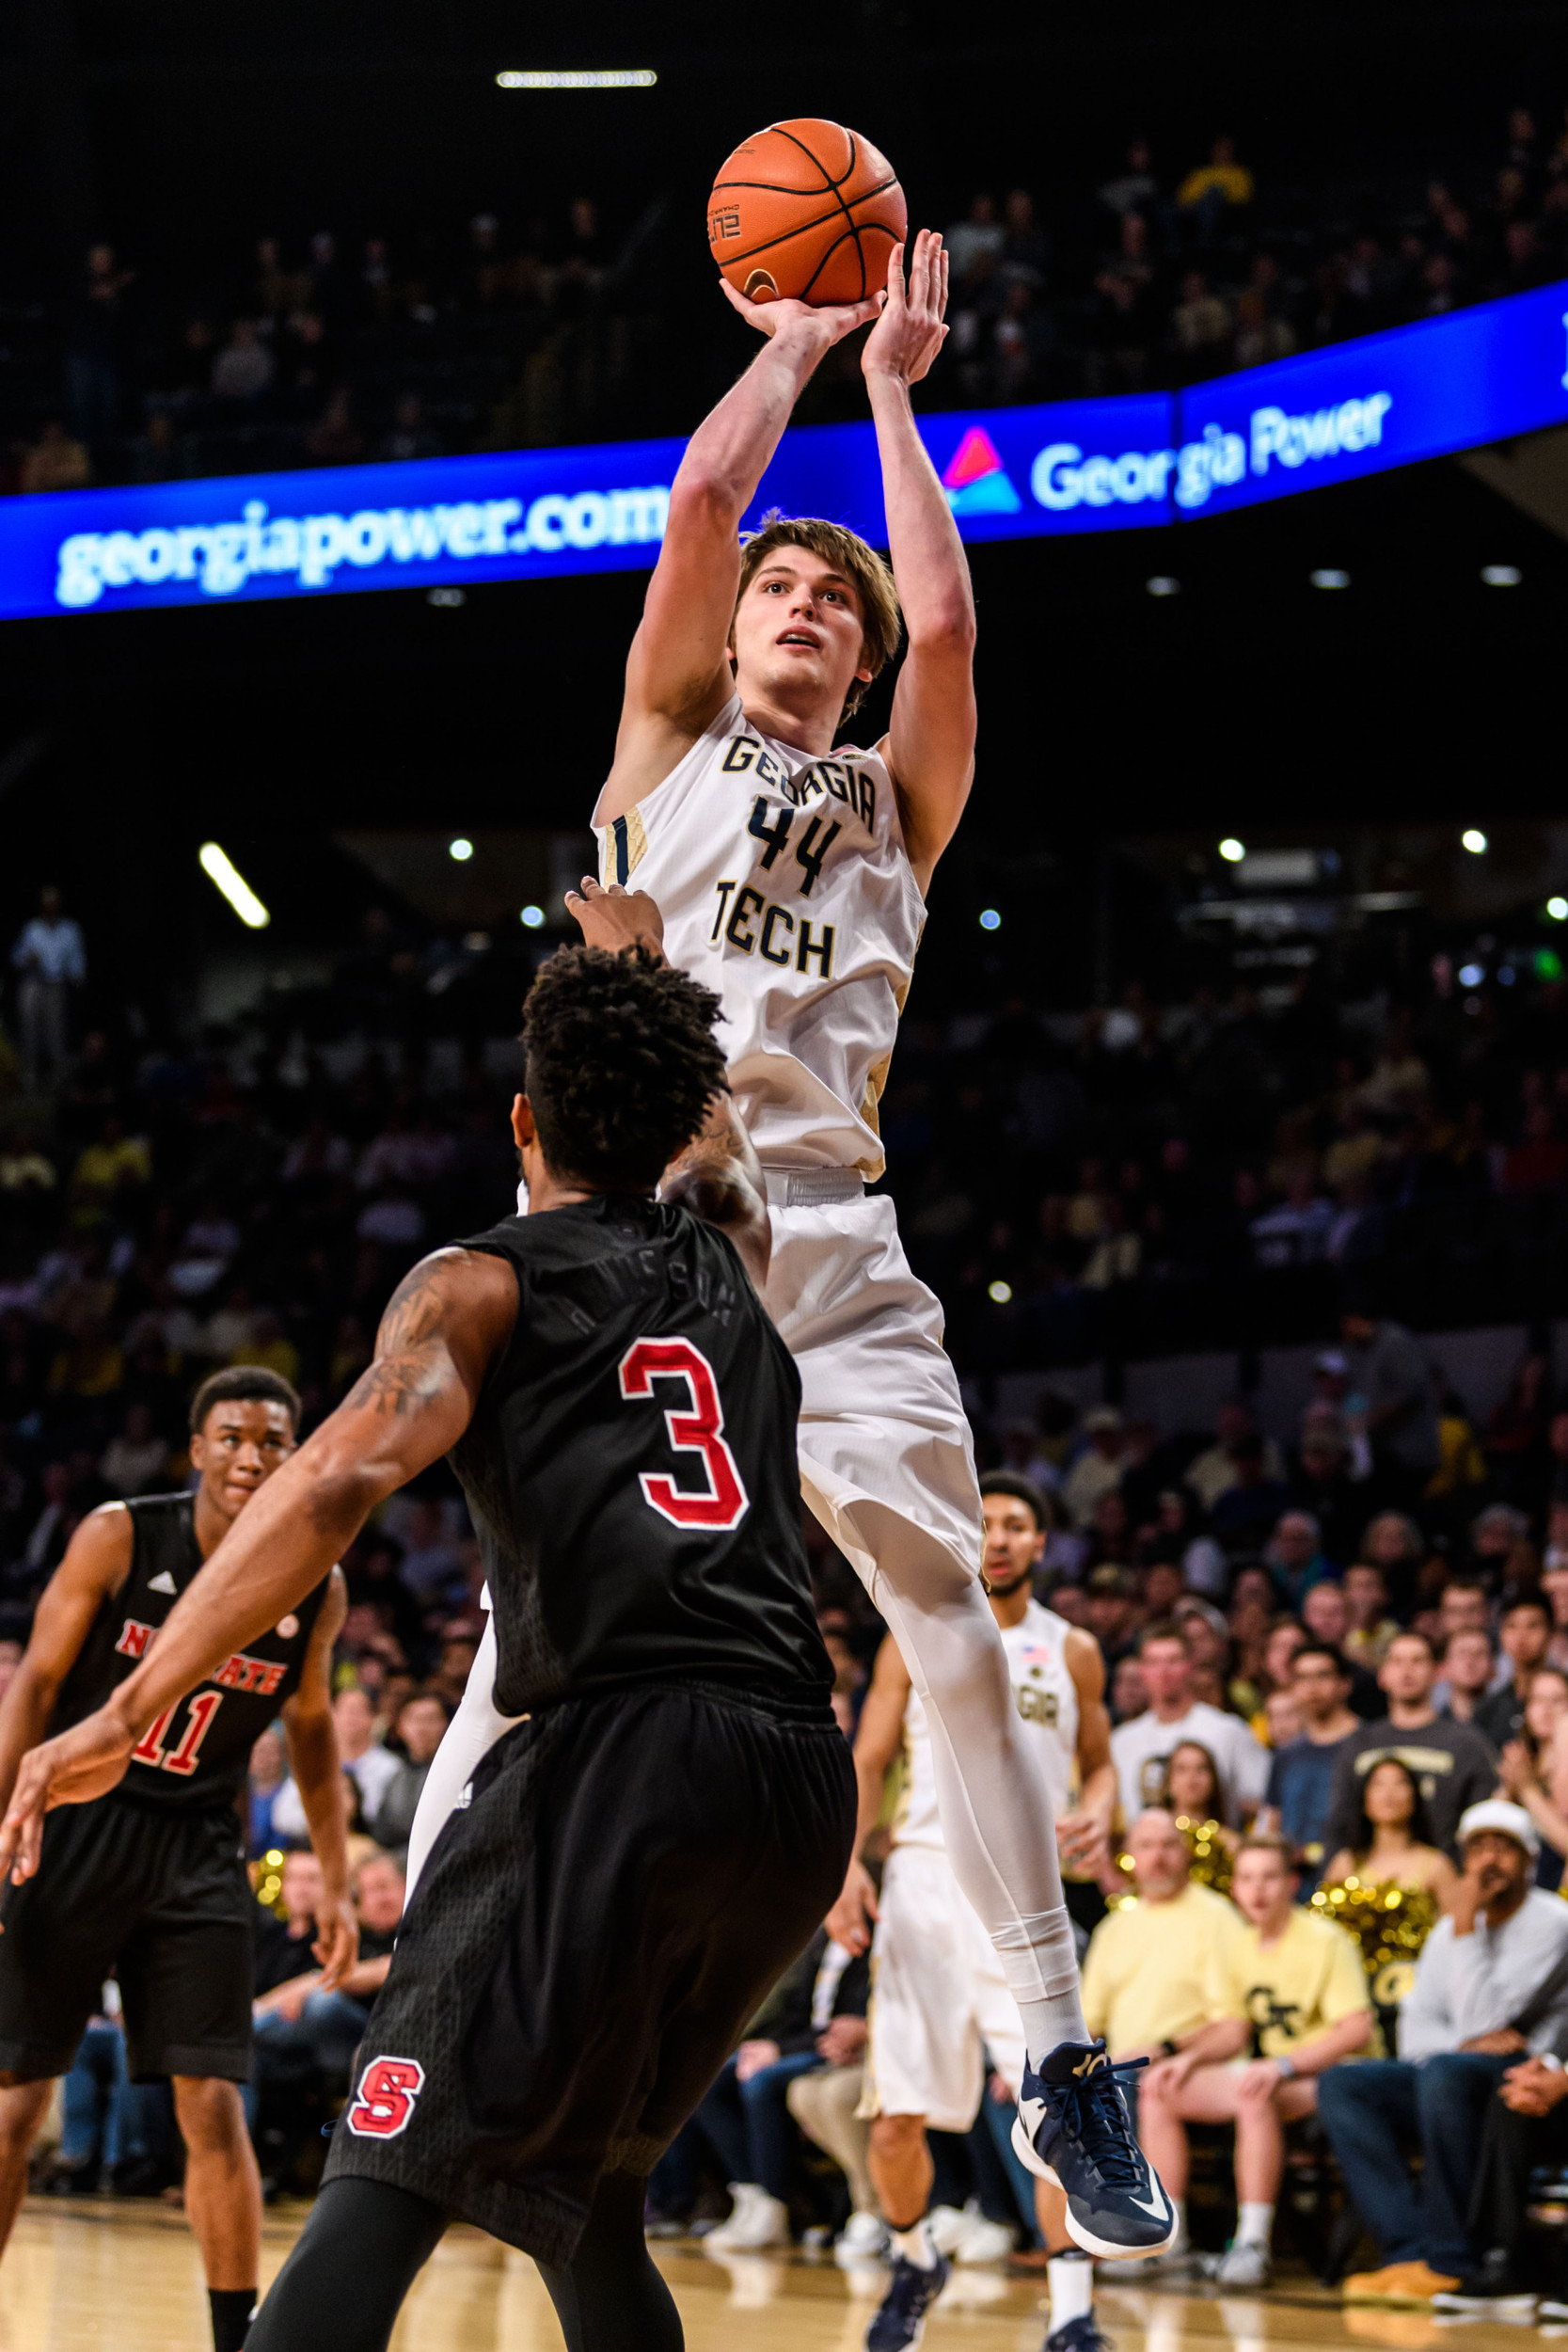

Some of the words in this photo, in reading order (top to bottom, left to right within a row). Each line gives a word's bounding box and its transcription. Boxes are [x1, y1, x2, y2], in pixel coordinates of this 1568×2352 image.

[1032, 423, 1245, 508] Georgia
[1251, 390, 1392, 475] Power
[56, 484, 671, 607] georgiapower.com
[721, 736, 877, 835] GEORGIA
[746, 795, 843, 898] 44
[708, 879, 836, 980] TECH
[618, 1337, 750, 1530] 3
[131, 1690, 224, 1776] 11
